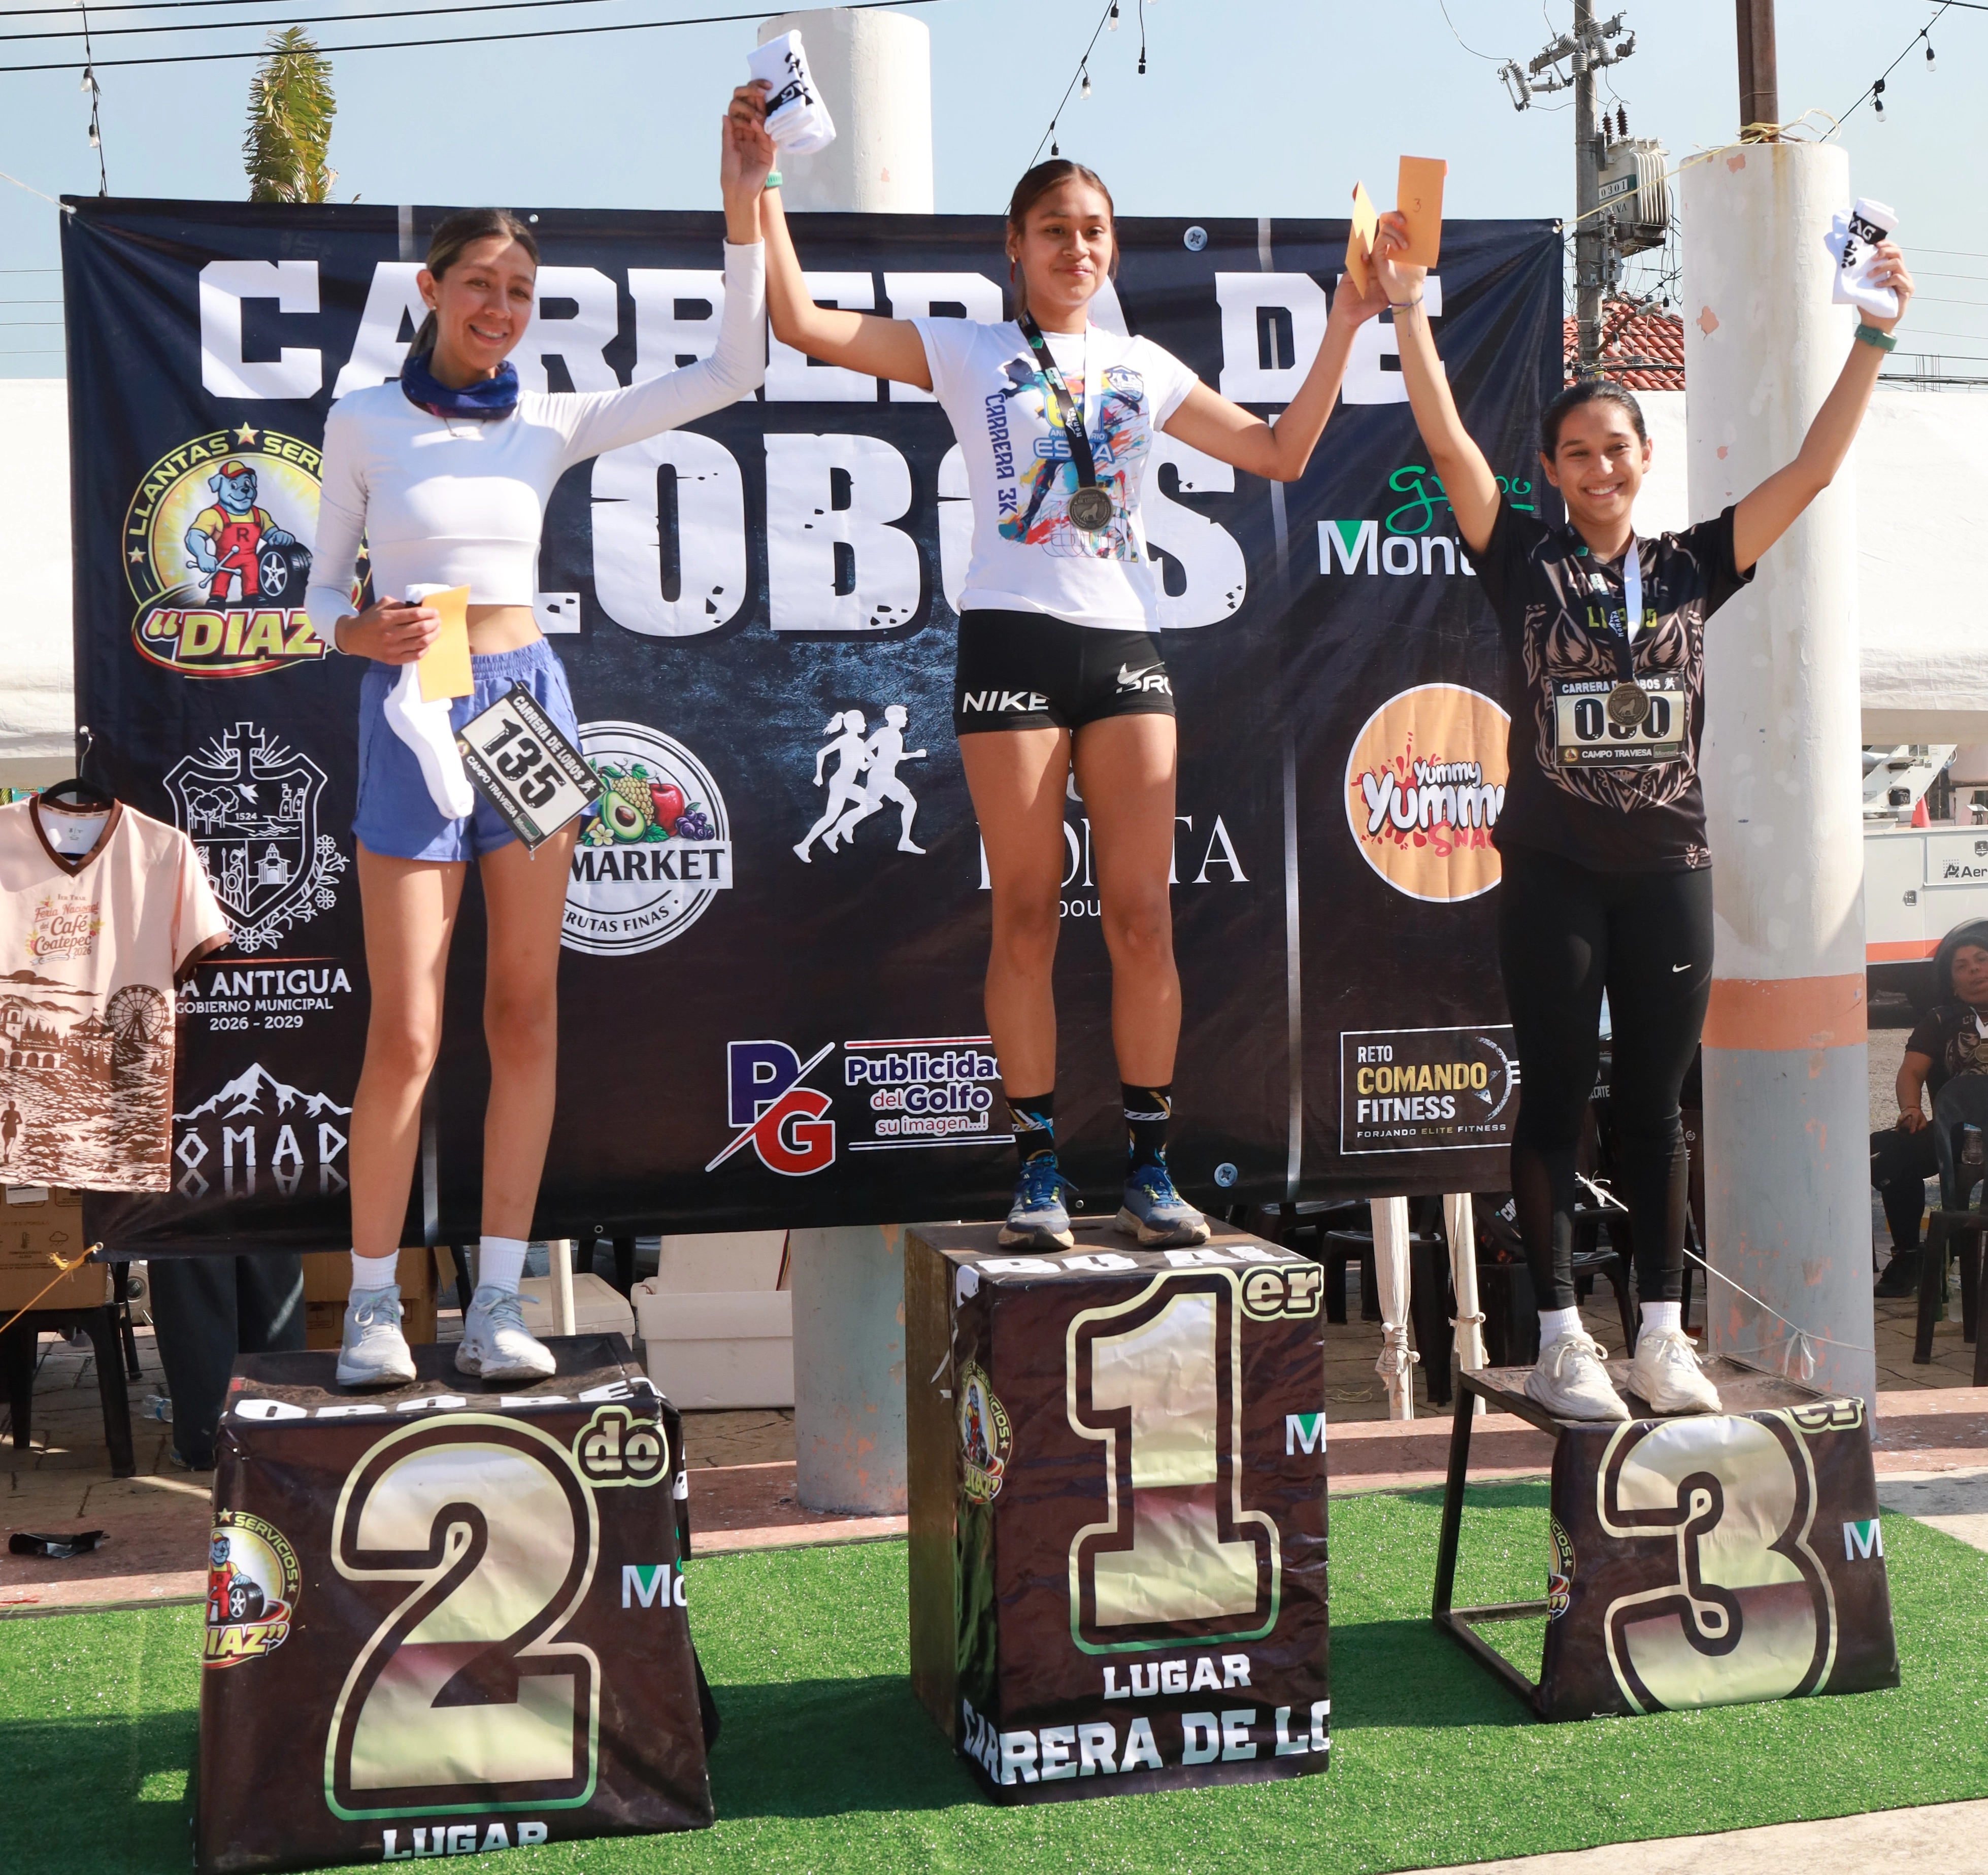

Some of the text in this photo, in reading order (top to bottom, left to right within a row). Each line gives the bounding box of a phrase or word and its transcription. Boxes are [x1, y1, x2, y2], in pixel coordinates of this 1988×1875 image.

[1601, 181, 1626, 197] 0301
[1413, 198, 1421, 213] 3
[985, 393, 1015, 480] CARRERA
[129, 436, 229, 536] LLANTAS
[998, 488, 1018, 516] 3K
[236, 527, 249, 543] R
[1562, 683, 1610, 694] CARRERA
[962, 690, 1050, 714] NIKE
[512, 695, 585, 781] CARRERA DE LOBOS
[481, 717, 567, 809] 135
[1581, 749, 1652, 759] CAMPO TRAVIESA
[466, 755, 518, 818] CAMPO TRAVIESA
[1413, 760, 1482, 788] Yummy
[235, 812, 258, 821] 1524
[569, 849, 725, 882] MARKET
[35, 901, 99, 922] Feria Nacional
[623, 906, 670, 932] FINAS
[40, 915, 88, 936] del Café
[34, 935, 92, 957] Coatepec
[73, 946, 92, 956] 2026
[209, 968, 352, 997] ANTIGUA
[175, 997, 334, 1014] GOBIERNO MUNICIPAL
[209, 1016, 249, 1031] 2026
[263, 1015, 304, 1029] 2029
[1357, 1045, 1394, 1063] RETO
[1356, 1061, 1488, 1095] COMANDO
[872, 1084, 990, 1112] del Golfo
[1357, 1095, 1456, 1123] FITNESS
[877, 1121, 898, 1133] su
[1356, 1123, 1507, 1139] FORJANDO ELITE FITNESS
[234, 1515, 299, 1581] SERVICIOS
[1103, 1653, 1251, 1700] LUGAR
[964, 1697, 1163, 1785] CARRERA
[1181, 1709, 1256, 1766] DE
[383, 1821, 548, 1860] LUGAR
